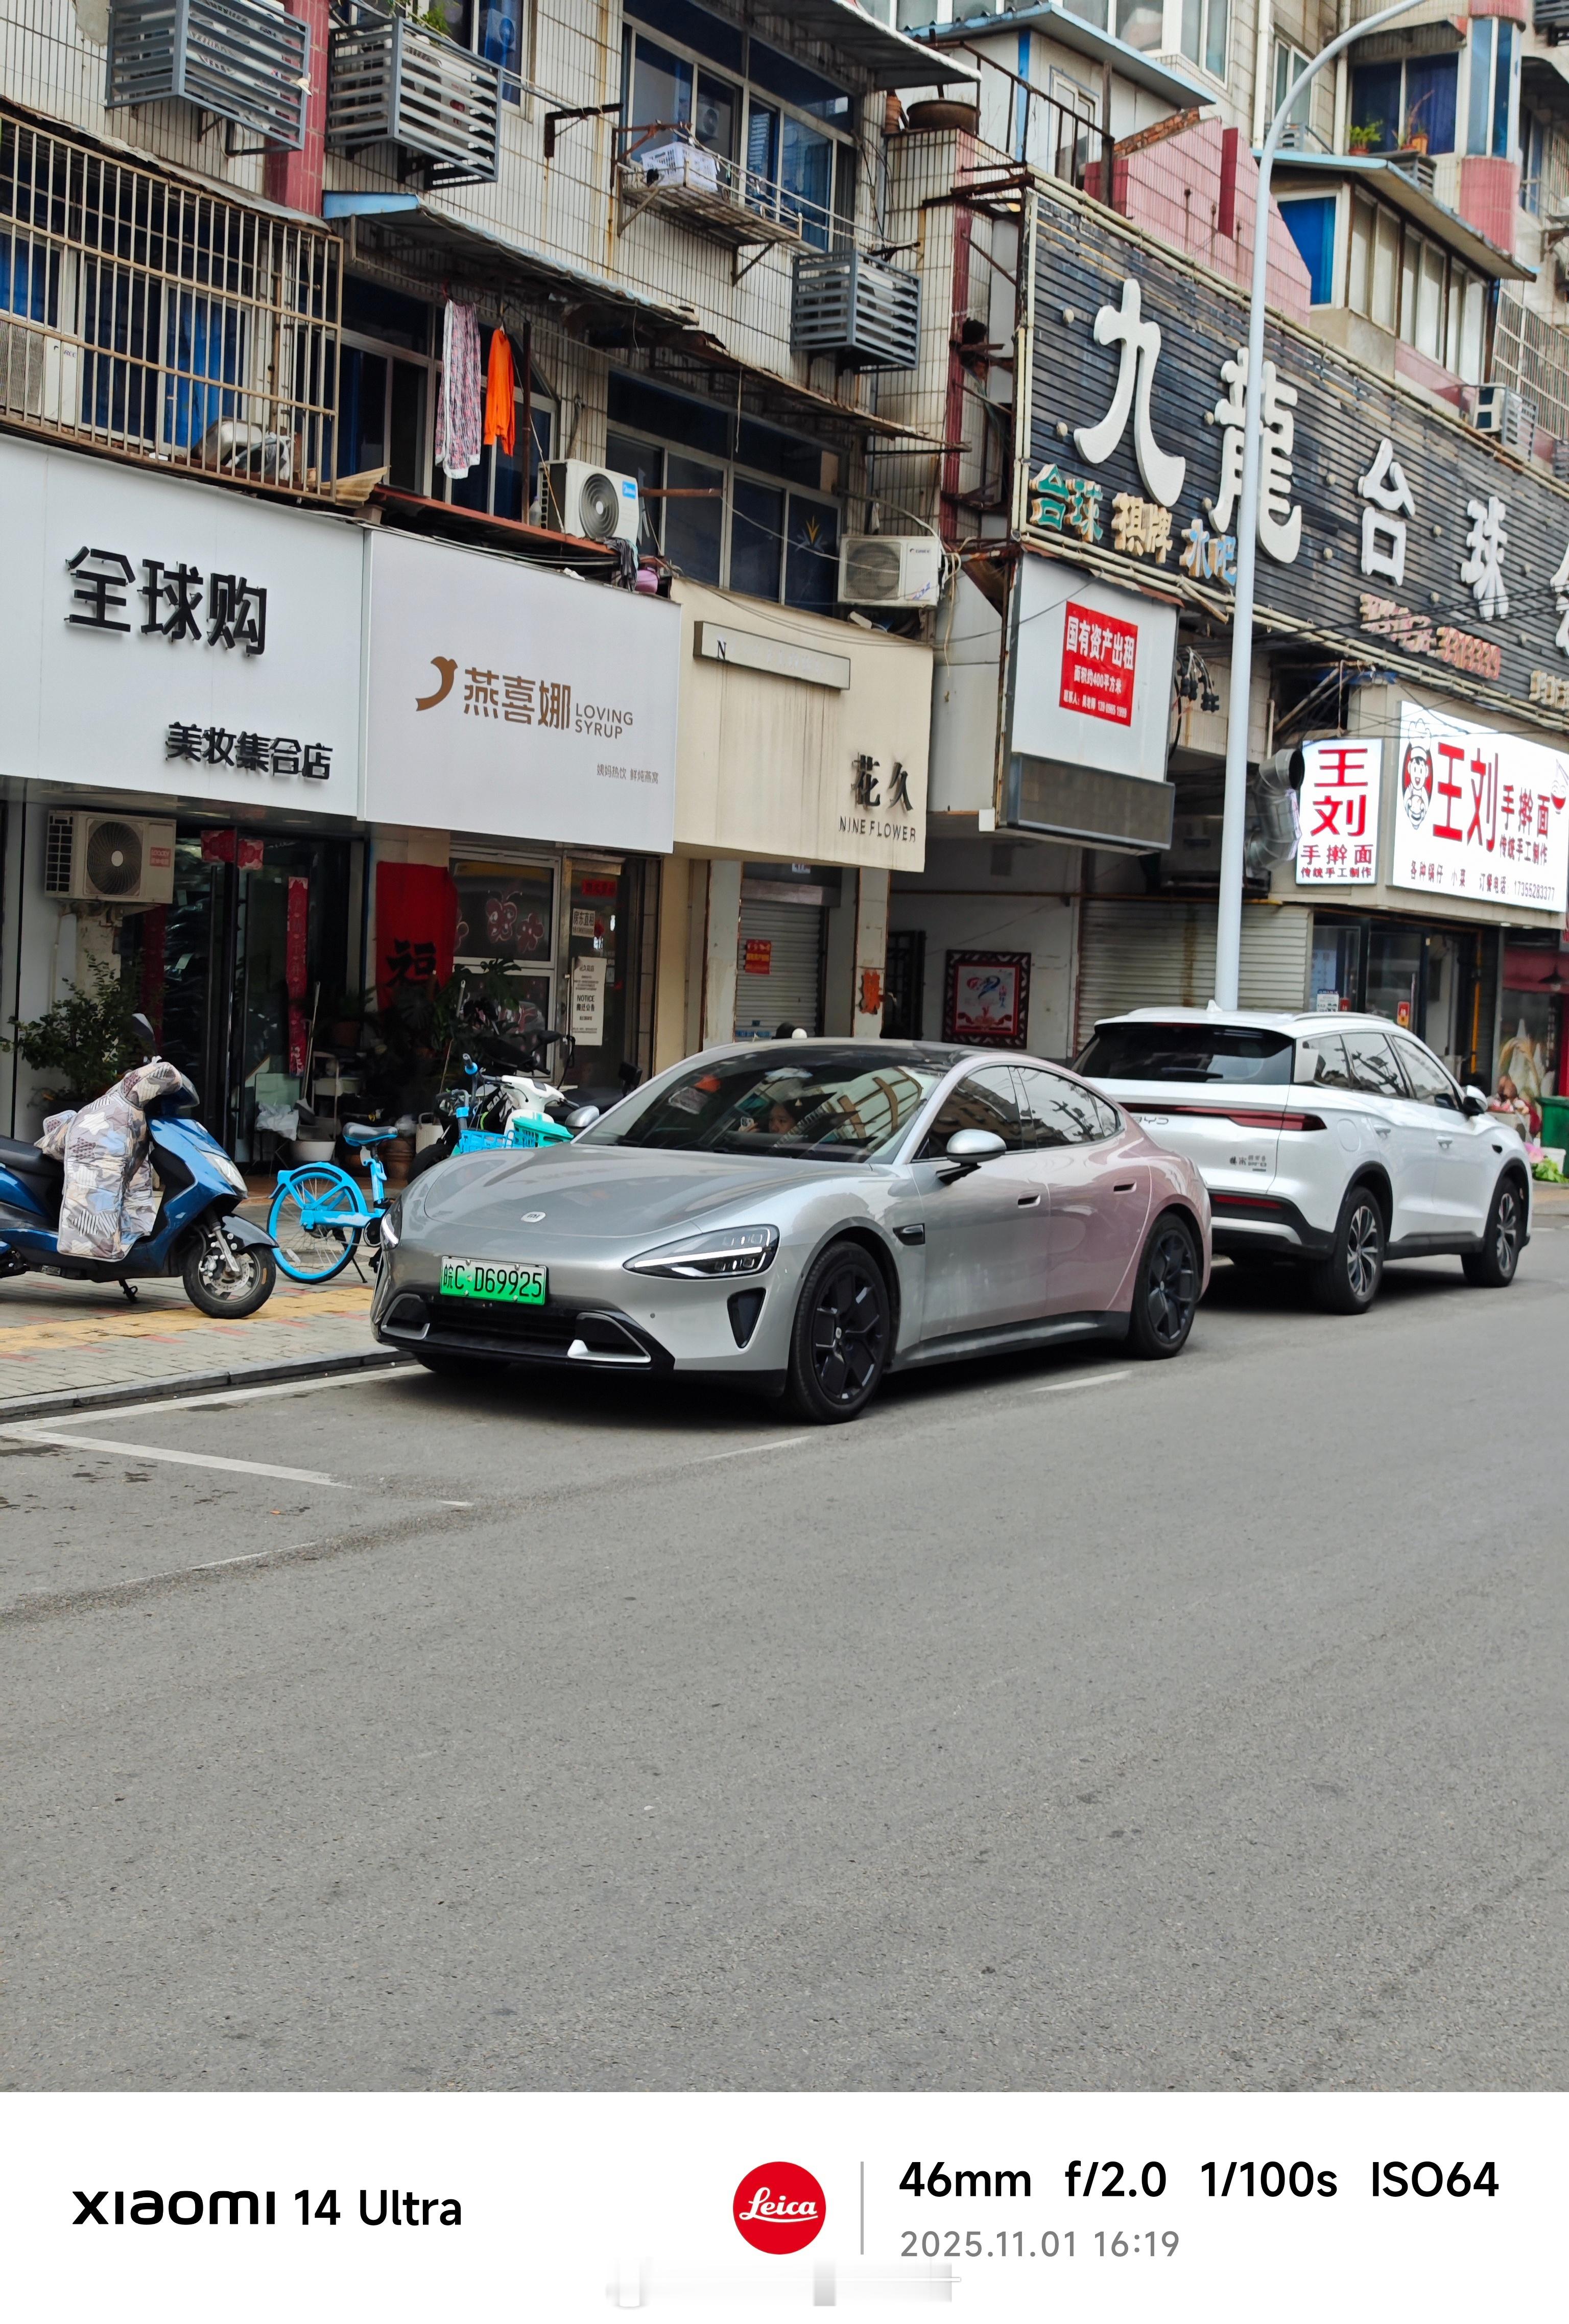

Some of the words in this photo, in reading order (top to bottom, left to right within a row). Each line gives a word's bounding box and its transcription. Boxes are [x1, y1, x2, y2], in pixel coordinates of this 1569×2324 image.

[1074, 278, 1569, 657] 九龍台球
[1029, 464, 1103, 542] 台球
[1112, 492, 1173, 563] 棋牌
[65, 546, 267, 655] 全球购
[1066, 615, 1135, 671] 国有资产出租
[464, 667, 571, 730] 燕喜娜
[576, 702, 633, 726] LOVING
[165, 722, 334, 779] 美妆集合店
[575, 719, 623, 739] SYRUP
[851, 752, 914, 812] 花久
[1311, 748, 1368, 837] 王刘
[1433, 742, 1499, 852] 王刘
[839, 816, 866, 835] NINE
[870, 820, 916, 842] FLOWER
[1501, 785, 1550, 839] 手擀面
[1300, 844, 1373, 865] 手擀面
[1301, 867, 1372, 879] 传统手工制作
[443, 1264, 465, 1290] 皖C
[474, 1267, 543, 1298] D69925
